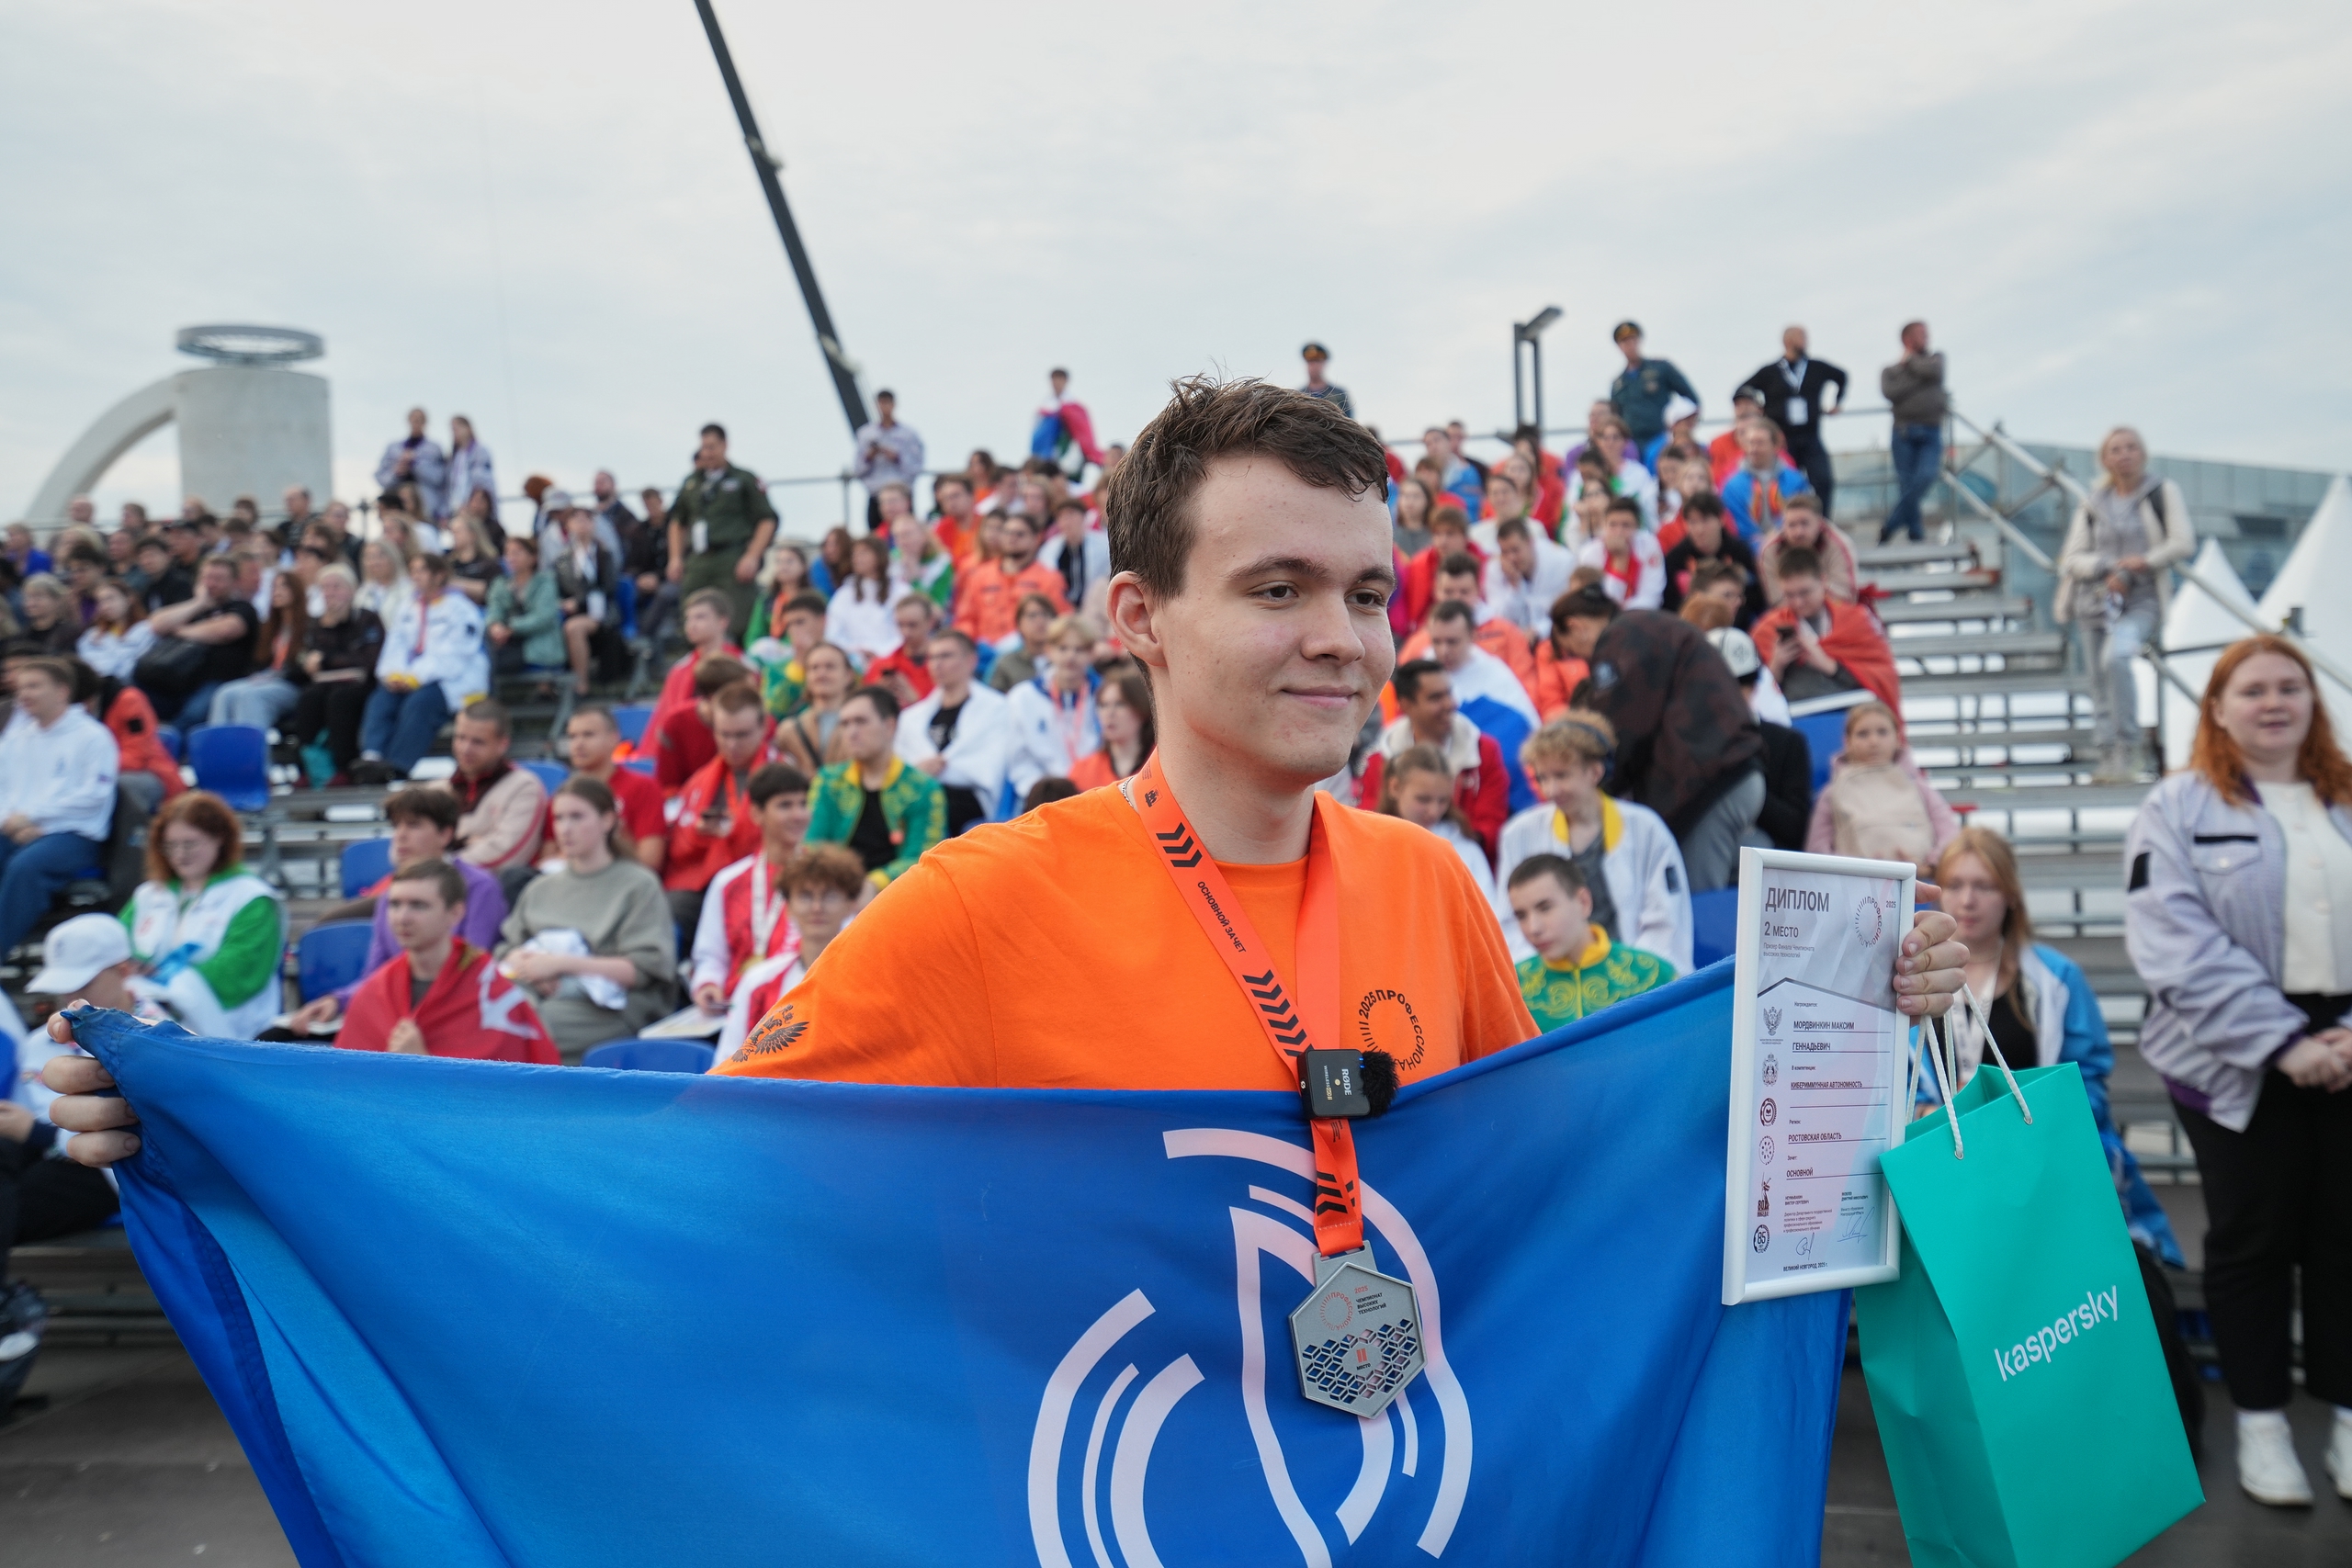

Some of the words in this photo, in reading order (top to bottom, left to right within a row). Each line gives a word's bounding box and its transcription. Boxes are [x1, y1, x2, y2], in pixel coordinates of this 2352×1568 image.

[1765, 887, 1830, 912] ДИПЛОМ
[1885, 900, 1897, 908] 2025
[1197, 881, 1230, 927] ОСНОВНОЙ
[1225, 927, 1247, 953] ЗАЧЕТ
[1764, 921, 1770, 936] 2
[1772, 926, 1799, 938] МЕСТО
[1375, 989, 1425, 1071] ПРОФЕССИОНА
[1793, 1021, 1831, 1030] МОРДВИНКИН
[1831, 1021, 1855, 1030] МАКСИМ
[1792, 1043, 1831, 1052] ГЕННАДЬЕВИЧ
[1829, 1080, 1862, 1089] АВТОНОМНОСТЬ
[1788, 1134, 1821, 1142] РОСТОВСКАЯ
[1821, 1133, 1842, 1141] ОБЛАСТЬ
[1786, 1168, 1814, 1178] ОСНОВНОЙ
[1758, 1231, 1766, 1244] 85
[1354, 1285, 1369, 1294] 2025
[1355, 1292, 1383, 1304] ЧЕМПИОНАТ
[1357, 1300, 1379, 1310] ВЫСОКИХ
[1358, 1303, 1387, 1315] ТЕХНОЛОГИЙ
[1994, 1285, 2119, 1382] kaspersky
